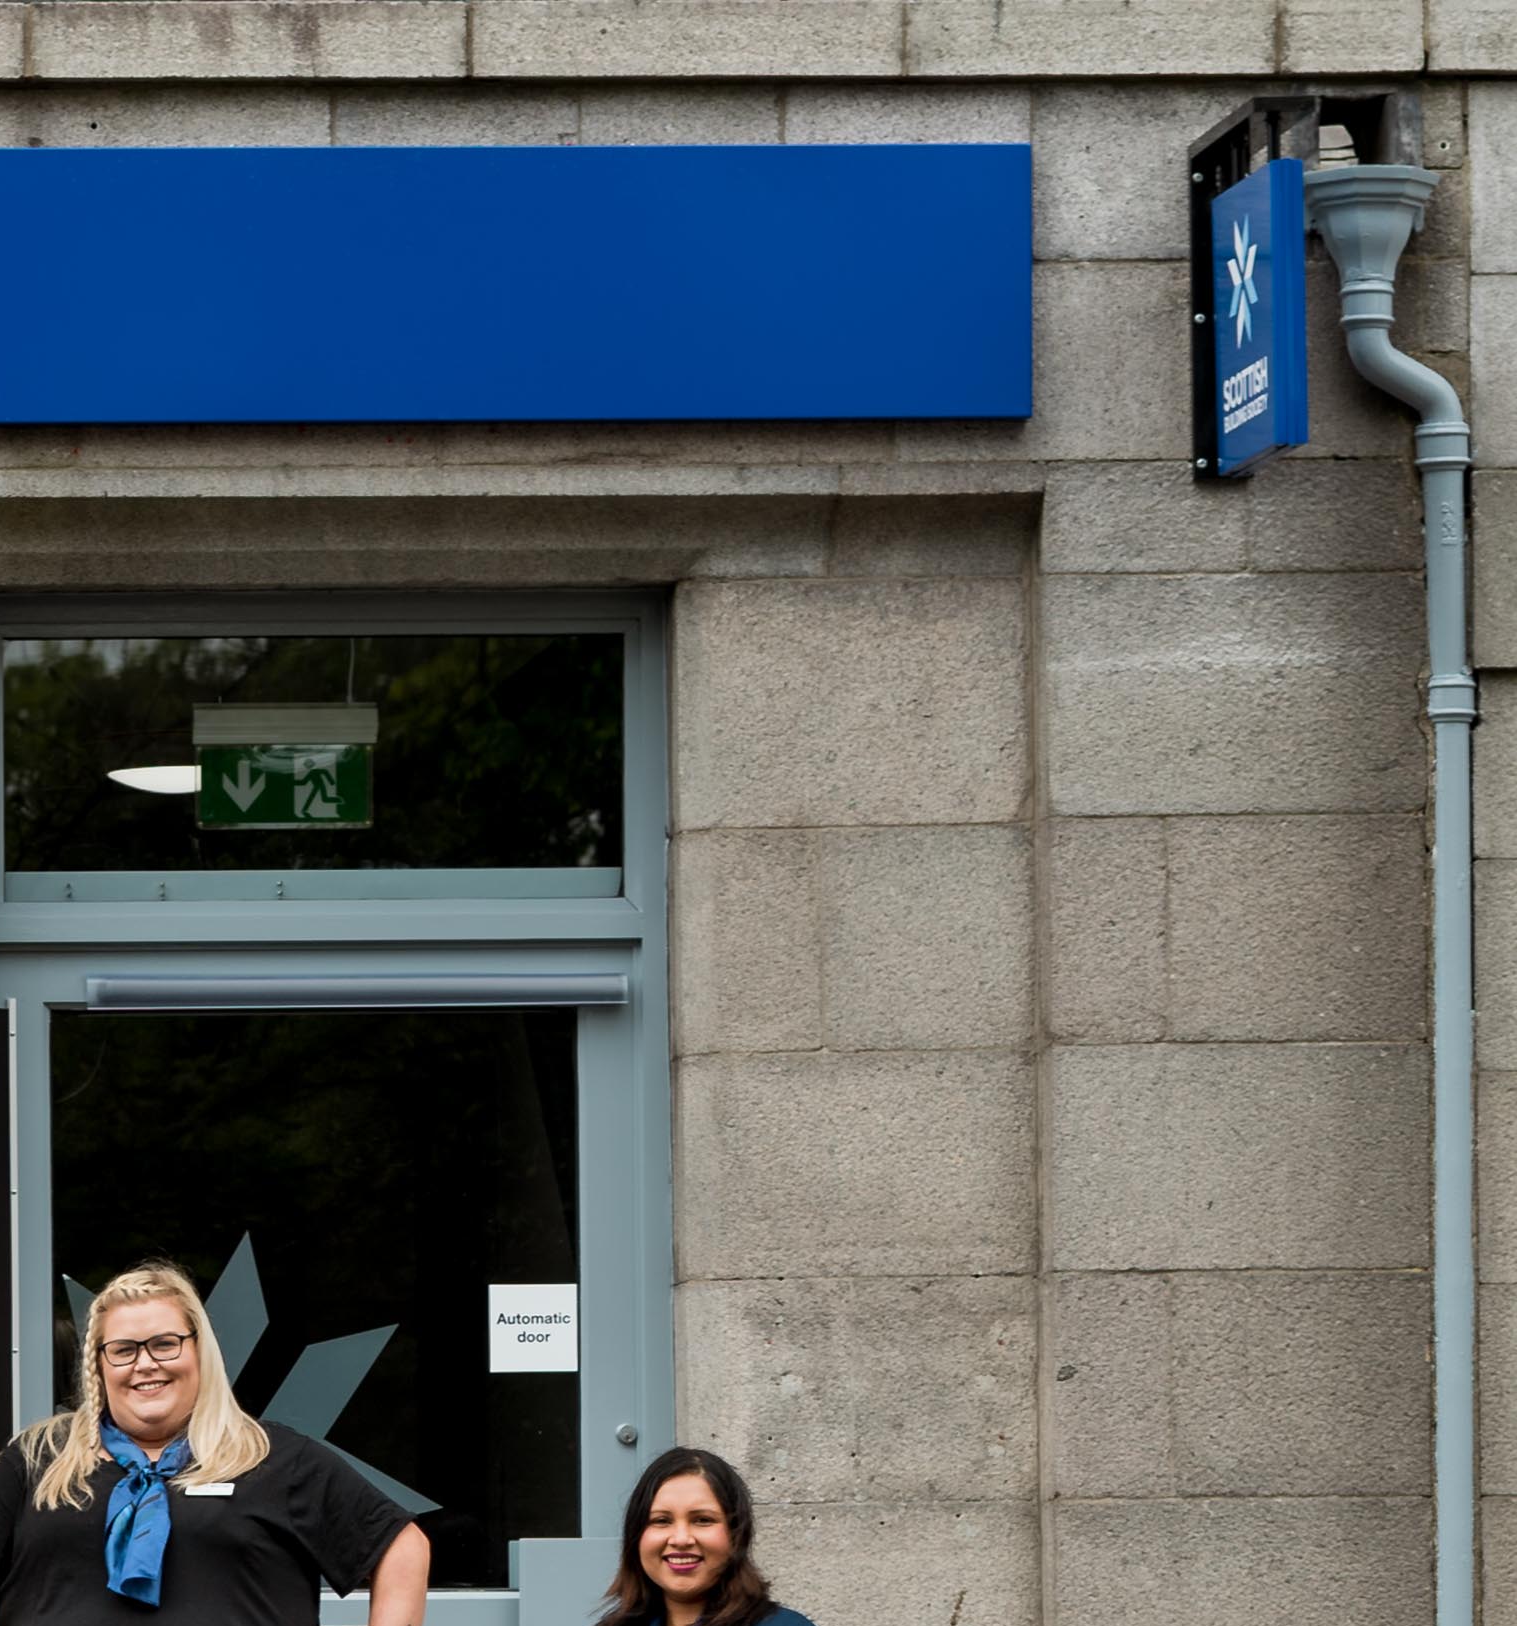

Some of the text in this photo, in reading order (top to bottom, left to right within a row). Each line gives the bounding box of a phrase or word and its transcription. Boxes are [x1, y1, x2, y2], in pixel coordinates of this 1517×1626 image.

[1223, 356, 1269, 412] SCOTTISH
[496, 1312, 571, 1325] Automatic
[517, 1331, 551, 1343] door
